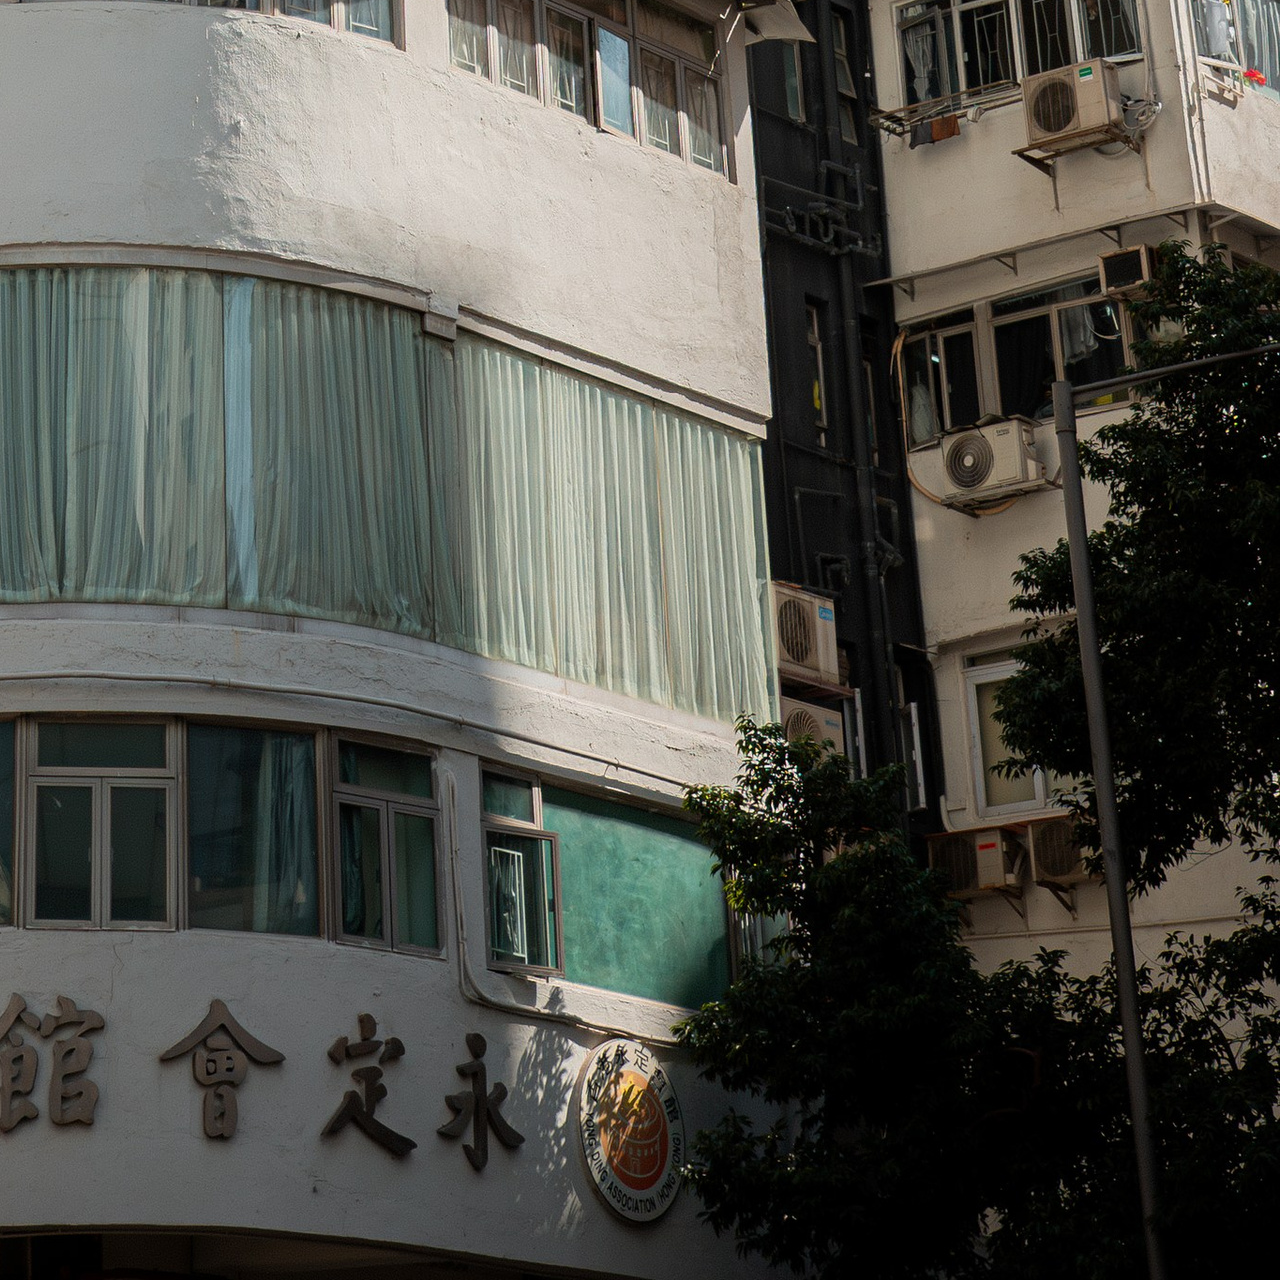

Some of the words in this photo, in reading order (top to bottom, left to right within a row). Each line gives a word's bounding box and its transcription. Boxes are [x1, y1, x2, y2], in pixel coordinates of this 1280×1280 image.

[585, 1112, 597, 1147] YONG
[591, 1151, 609, 1183] DING
[606, 1181, 656, 1214] ASSOCIATION
